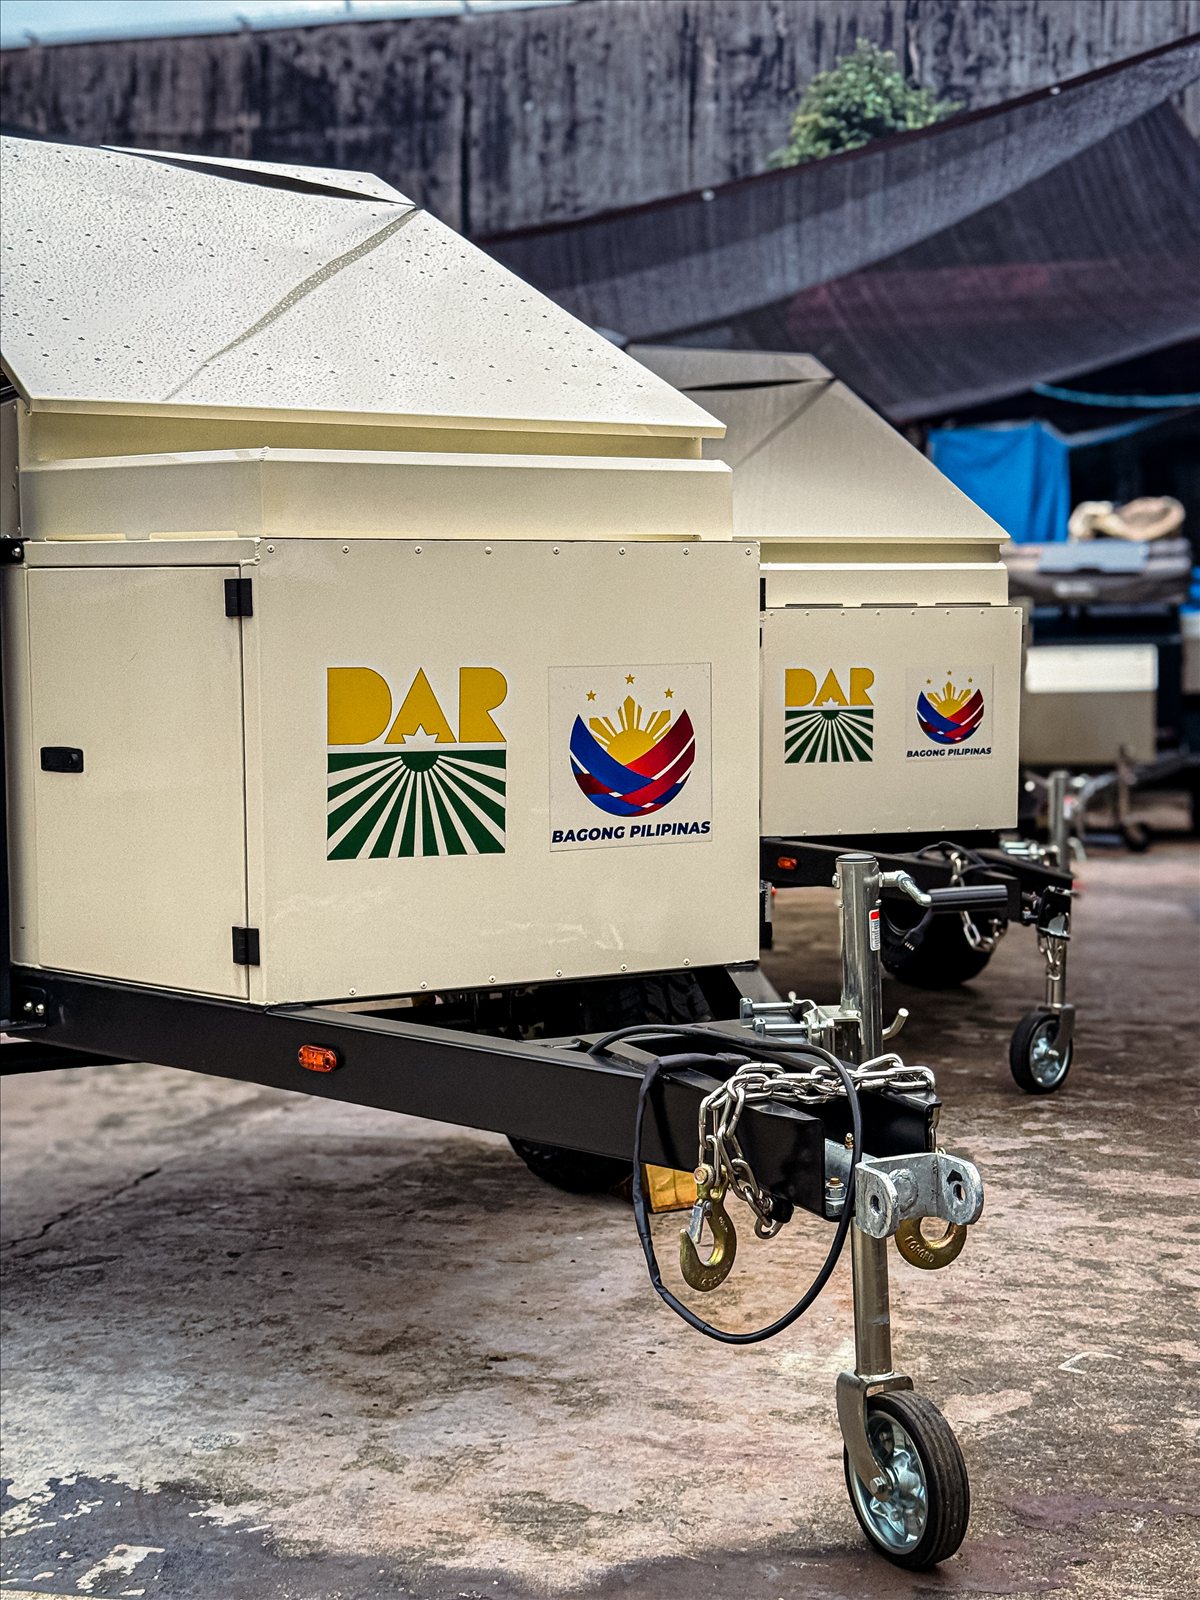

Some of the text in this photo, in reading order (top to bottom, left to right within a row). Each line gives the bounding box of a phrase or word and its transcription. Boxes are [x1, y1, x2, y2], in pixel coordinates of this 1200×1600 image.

[785, 667, 874, 706] DAR
[327, 667, 507, 745] DAR
[906, 747, 992, 757] BAGONG PILIPINAS
[552, 821, 711, 843] BAGONG PILIPINAS
